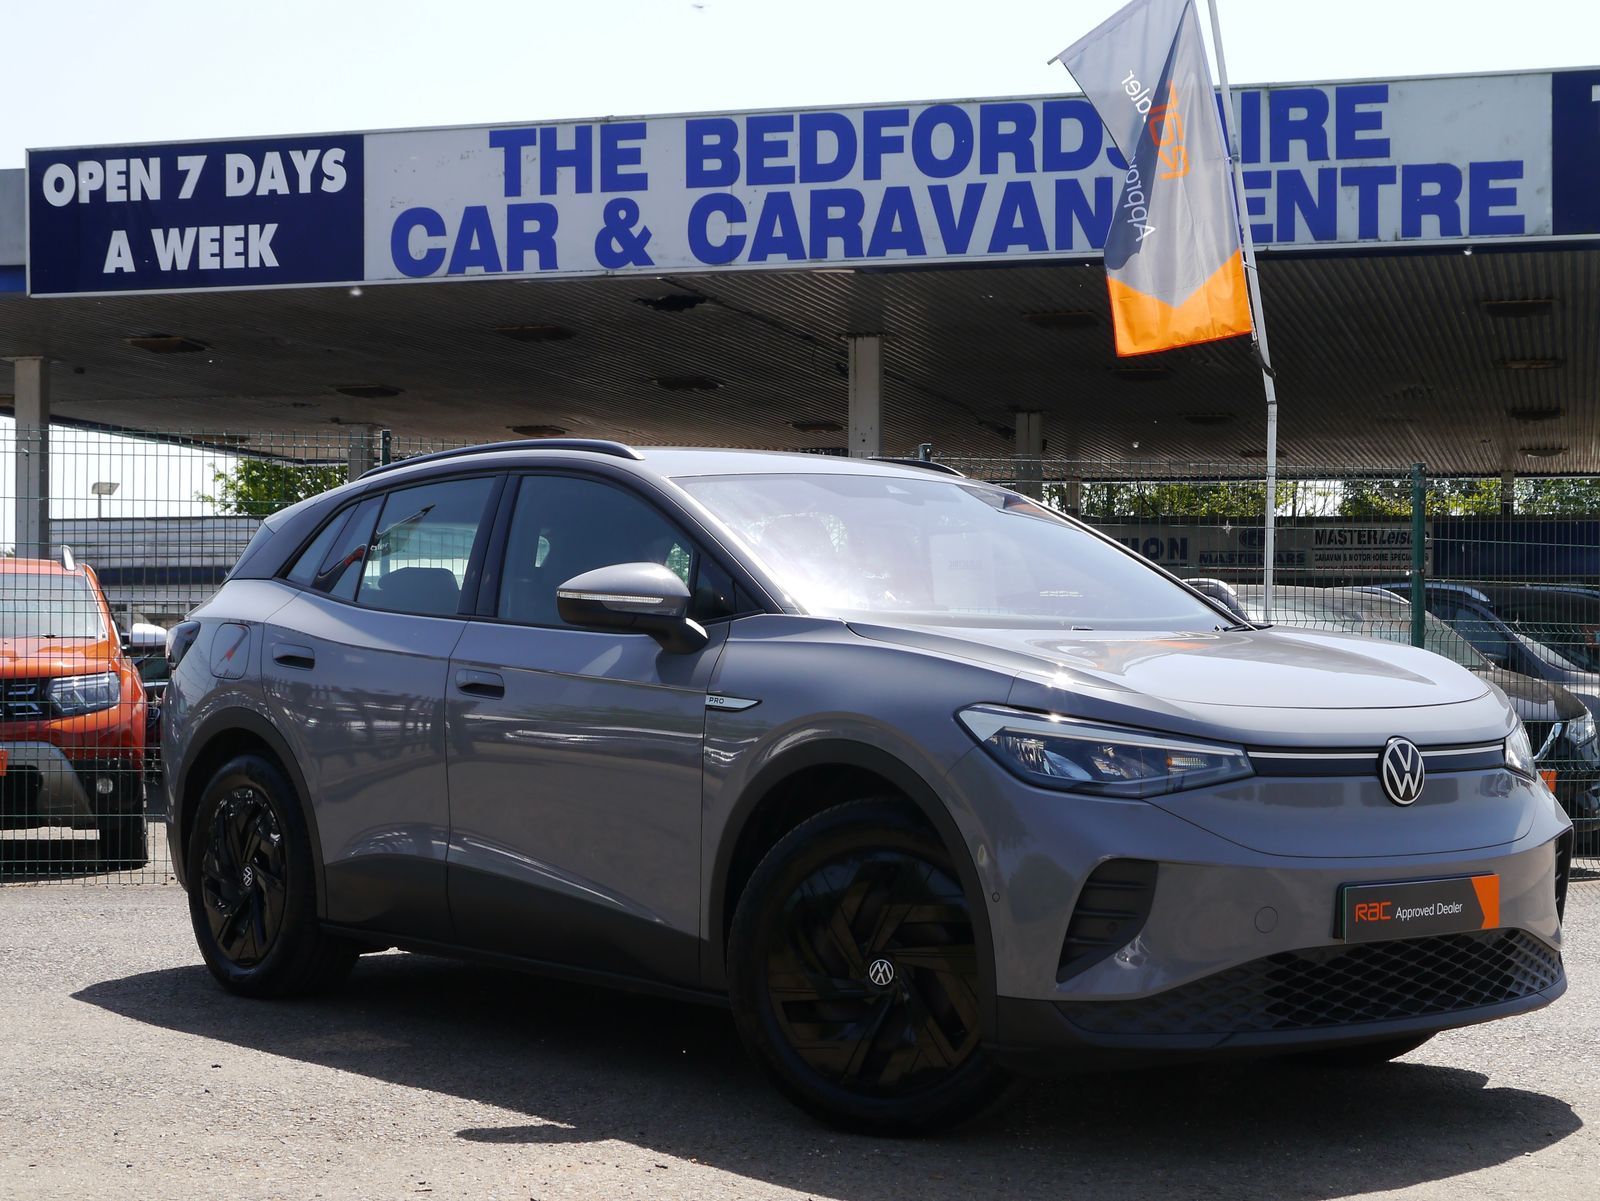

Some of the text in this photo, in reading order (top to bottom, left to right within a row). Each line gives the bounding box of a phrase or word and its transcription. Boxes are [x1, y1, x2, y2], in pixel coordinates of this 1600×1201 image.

[489, 84, 1390, 197] THE BEDFORDIRE
[42, 148, 347, 206] OPEN 7 DAYS
[391, 160, 1525, 277] CAR & CARAVAN ENTRE
[103, 224, 280, 273] A WEEK
[1114, 537, 1188, 560] ION
[708, 696, 725, 705] PRO
[1383, 738, 1425, 805] VW
[1395, 904, 1435, 921] Approved
[1436, 901, 1463, 915] Dealer
